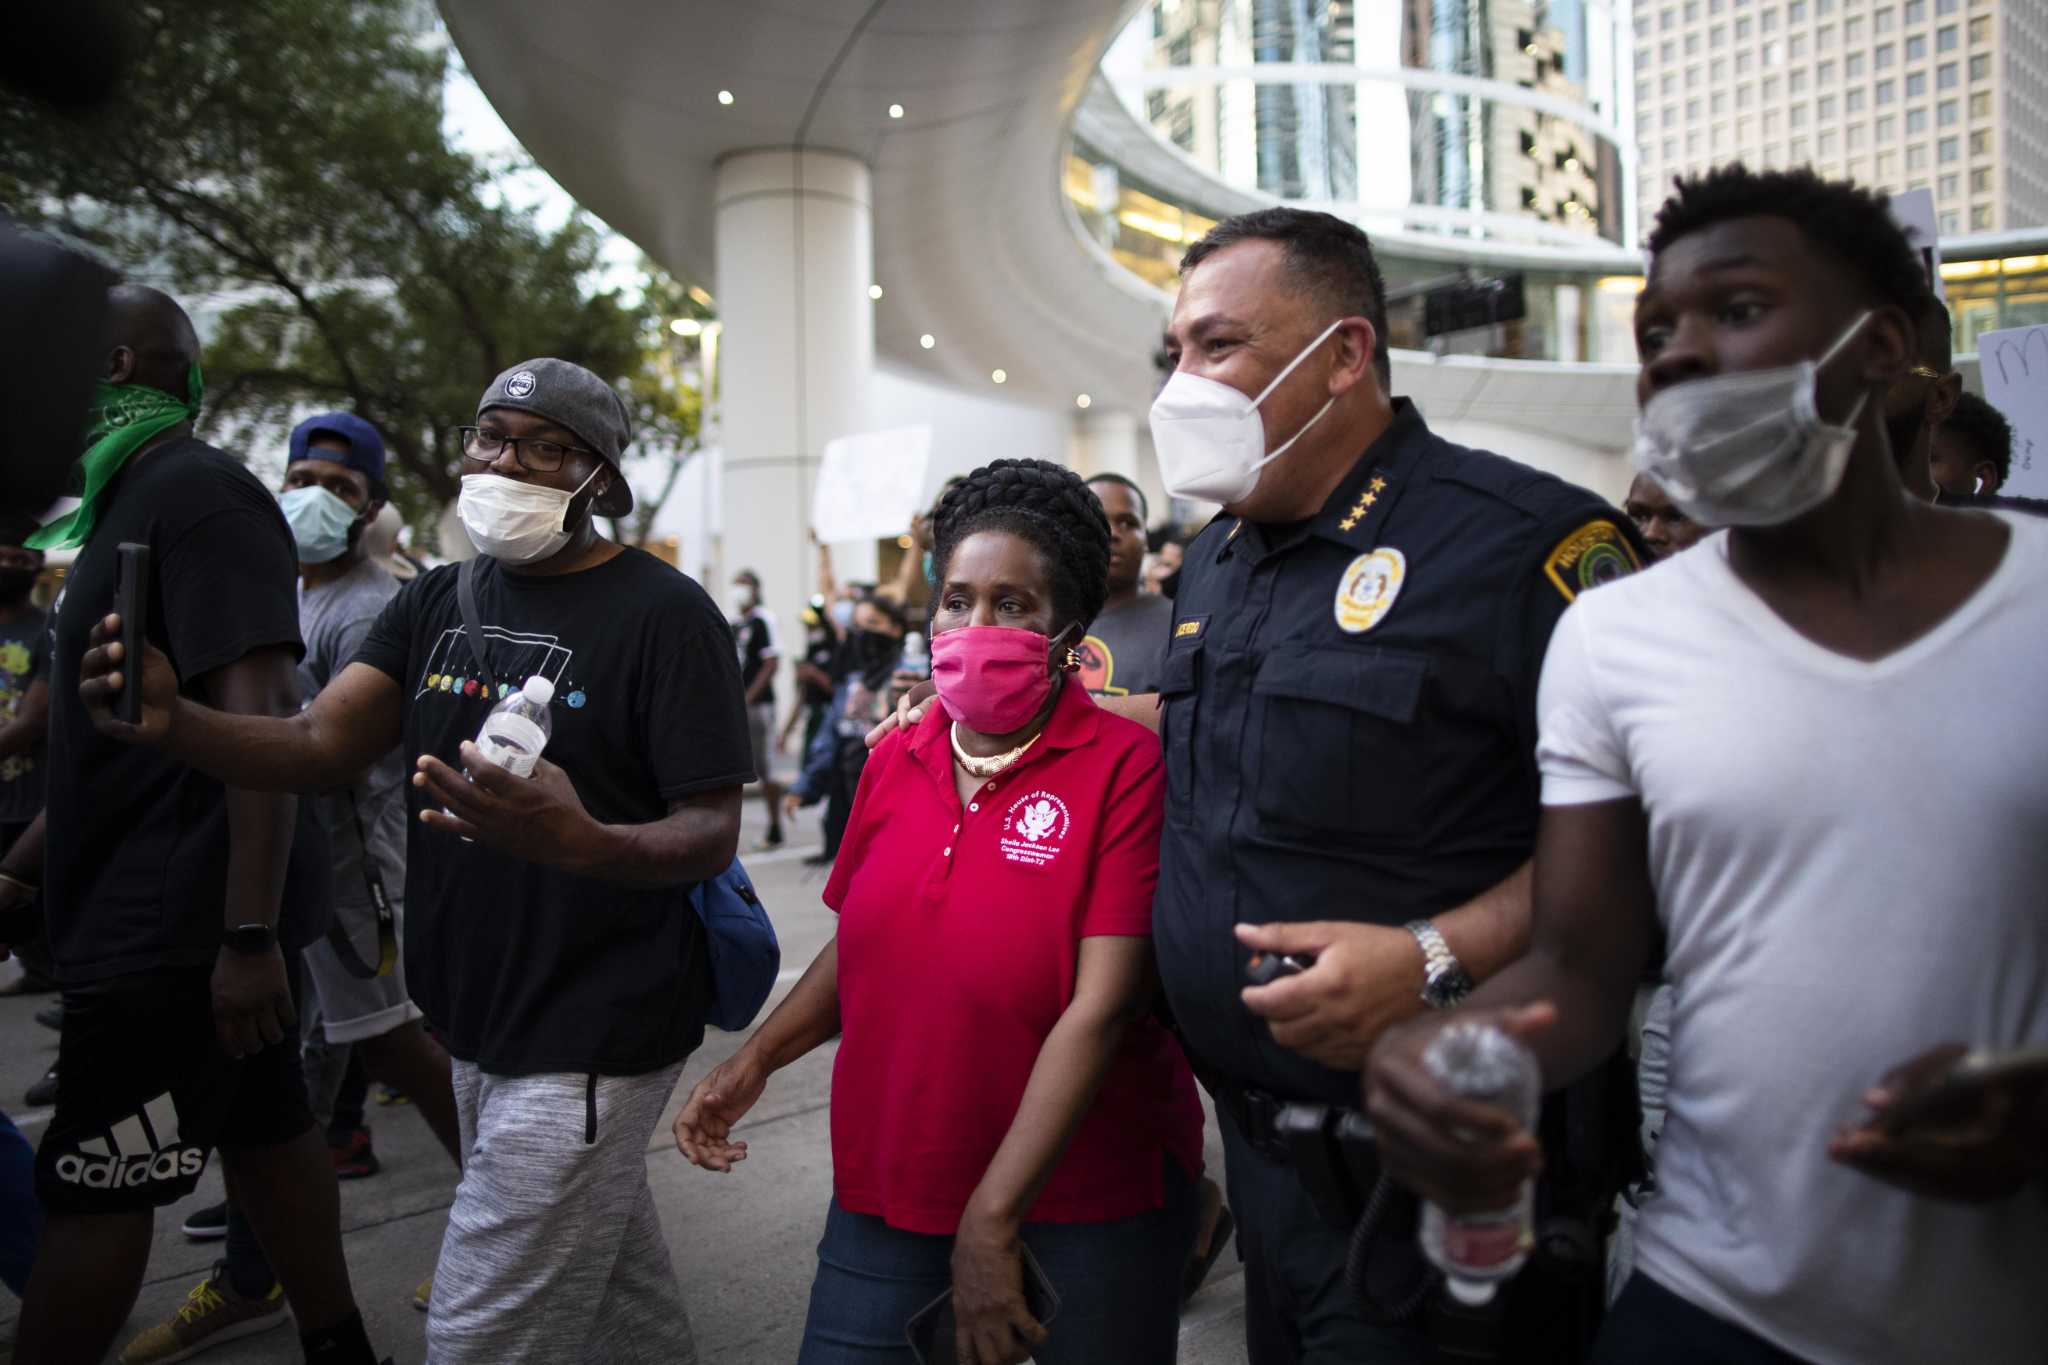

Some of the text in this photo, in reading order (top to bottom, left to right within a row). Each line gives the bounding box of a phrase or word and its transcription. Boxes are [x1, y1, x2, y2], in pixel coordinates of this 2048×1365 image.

[1003, 790, 1070, 839] U.S. House of Representatives
[1001, 845, 1055, 859] Congresswoman
[1021, 841, 1048, 851] Jackson
[55, 1148, 203, 1189] adidas
